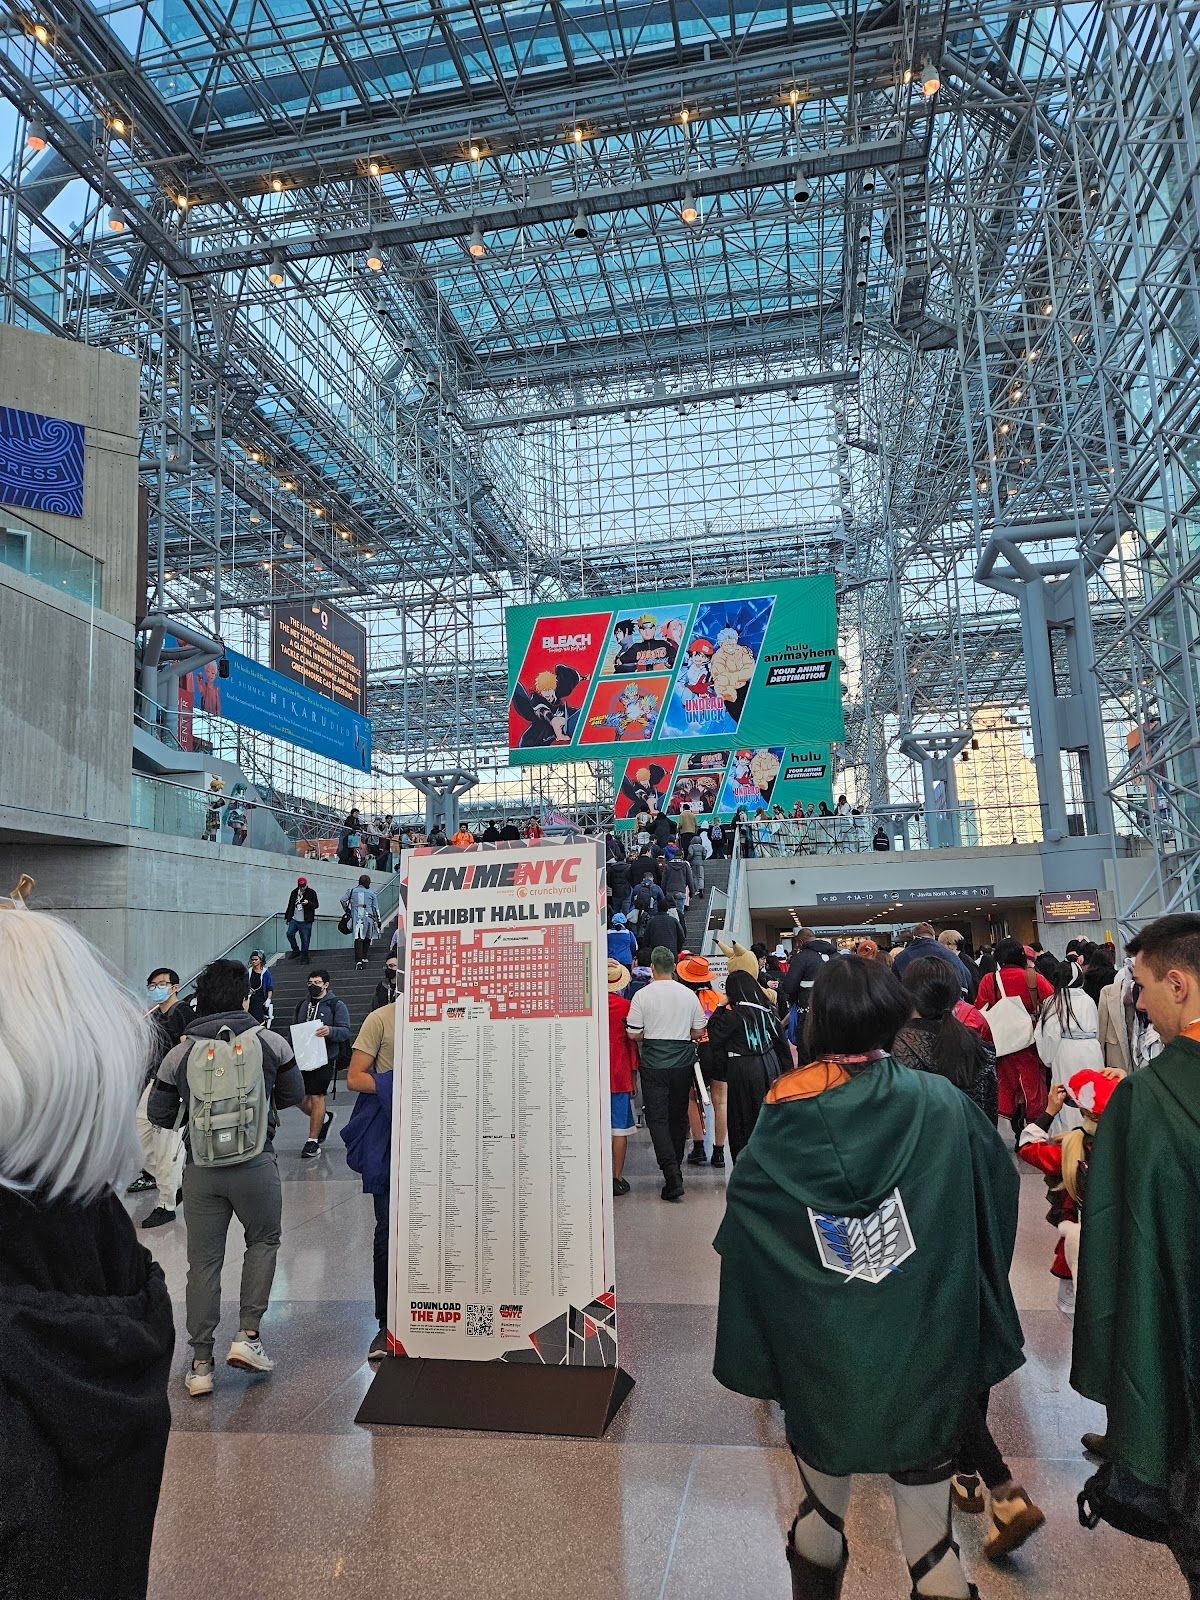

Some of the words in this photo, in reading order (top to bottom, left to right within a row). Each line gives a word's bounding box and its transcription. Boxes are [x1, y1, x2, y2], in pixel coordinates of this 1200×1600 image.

[279, 621, 290, 634] THE
[300, 633, 313, 647] ZERO
[290, 616, 300, 629] THE
[315, 631, 332, 647] CENTER
[332, 642, 341, 654] HAS
[542, 633, 592, 649] BLEACH
[764, 648, 836, 662] animayhem
[786, 643, 808, 651] hulu
[280, 644, 300, 661] TACKLE
[300, 655, 320, 671] CLIMATE
[320, 667, 337, 682] CHANGE
[294, 641, 312, 657] GLOBAL
[312, 651, 334, 670] INDUSTRY
[334, 664, 349, 678] EFFORT
[291, 661, 323, 684] GREENHOUSE
[770, 672, 826, 683] DESTINATION
[773, 667, 796, 676] YOUR
[797, 664, 826, 673] ANIME
[270, 691, 327, 727] HIKARU
[685, 696, 724, 711] UNDEAD
[685, 708, 725, 724] UNLUCK
[791, 751, 822, 763] hulu
[520, 857, 582, 886] NYC
[529, 885, 577, 896] crunchyroll
[413, 907, 486, 927] EXHIBIT
[490, 904, 539, 923] HALL
[544, 901, 591, 919] MAP
[411, 1301, 461, 1311] DOWNLOAD
[411, 1310, 434, 1322] THE
[436, 1311, 461, 1323] APP
